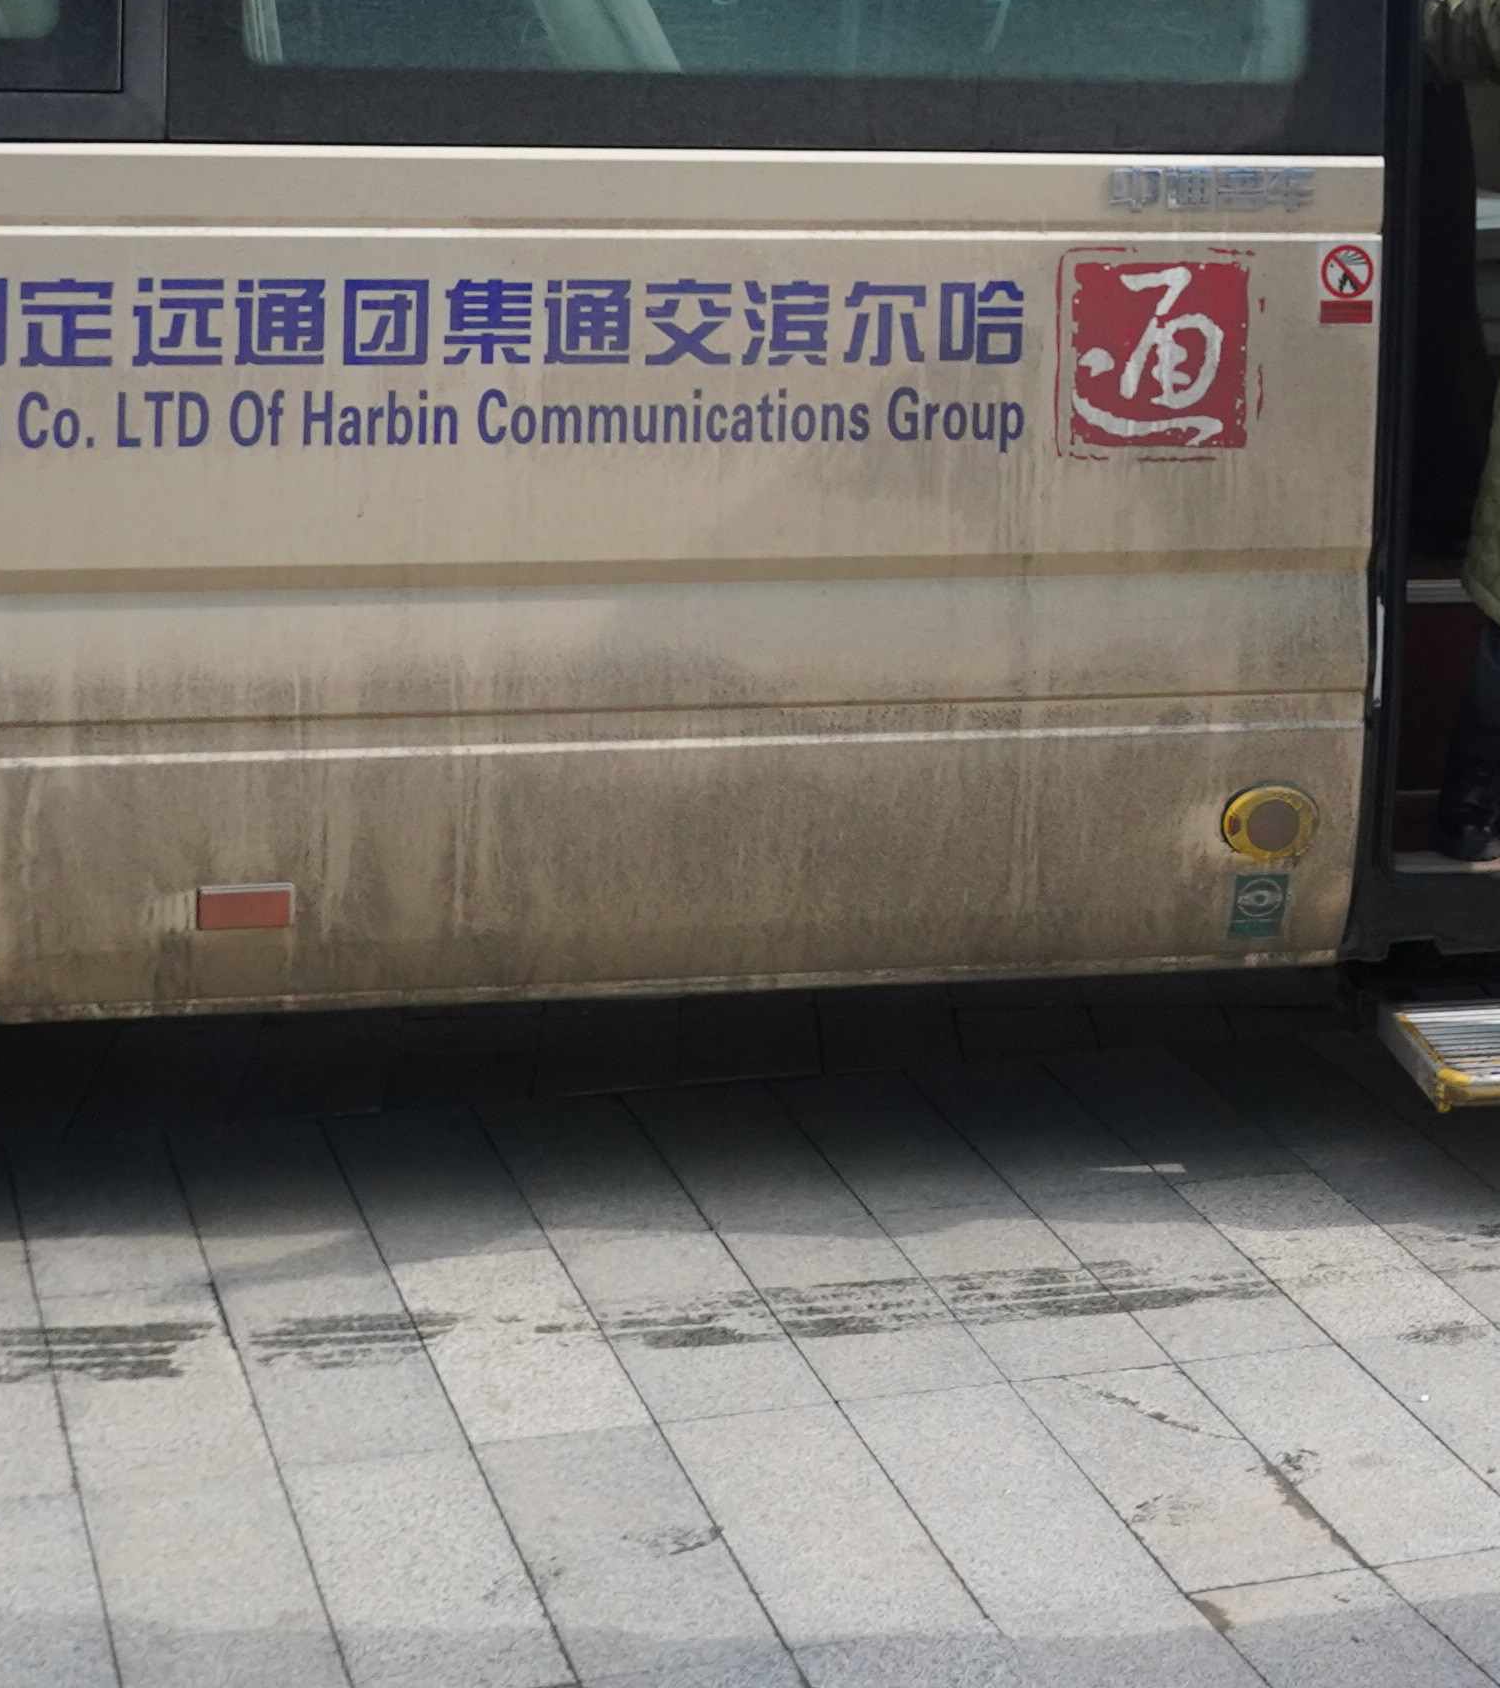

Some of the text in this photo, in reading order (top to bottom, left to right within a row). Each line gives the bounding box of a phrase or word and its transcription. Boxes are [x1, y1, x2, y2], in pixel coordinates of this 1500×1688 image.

[17, 391, 95, 449] Co.
[115, 391, 209, 448] LTD
[229, 391, 284, 447] Of
[303, 389, 459, 446] Harbin
[477, 388, 870, 445] Communications
[887, 386, 1025, 452] Group
